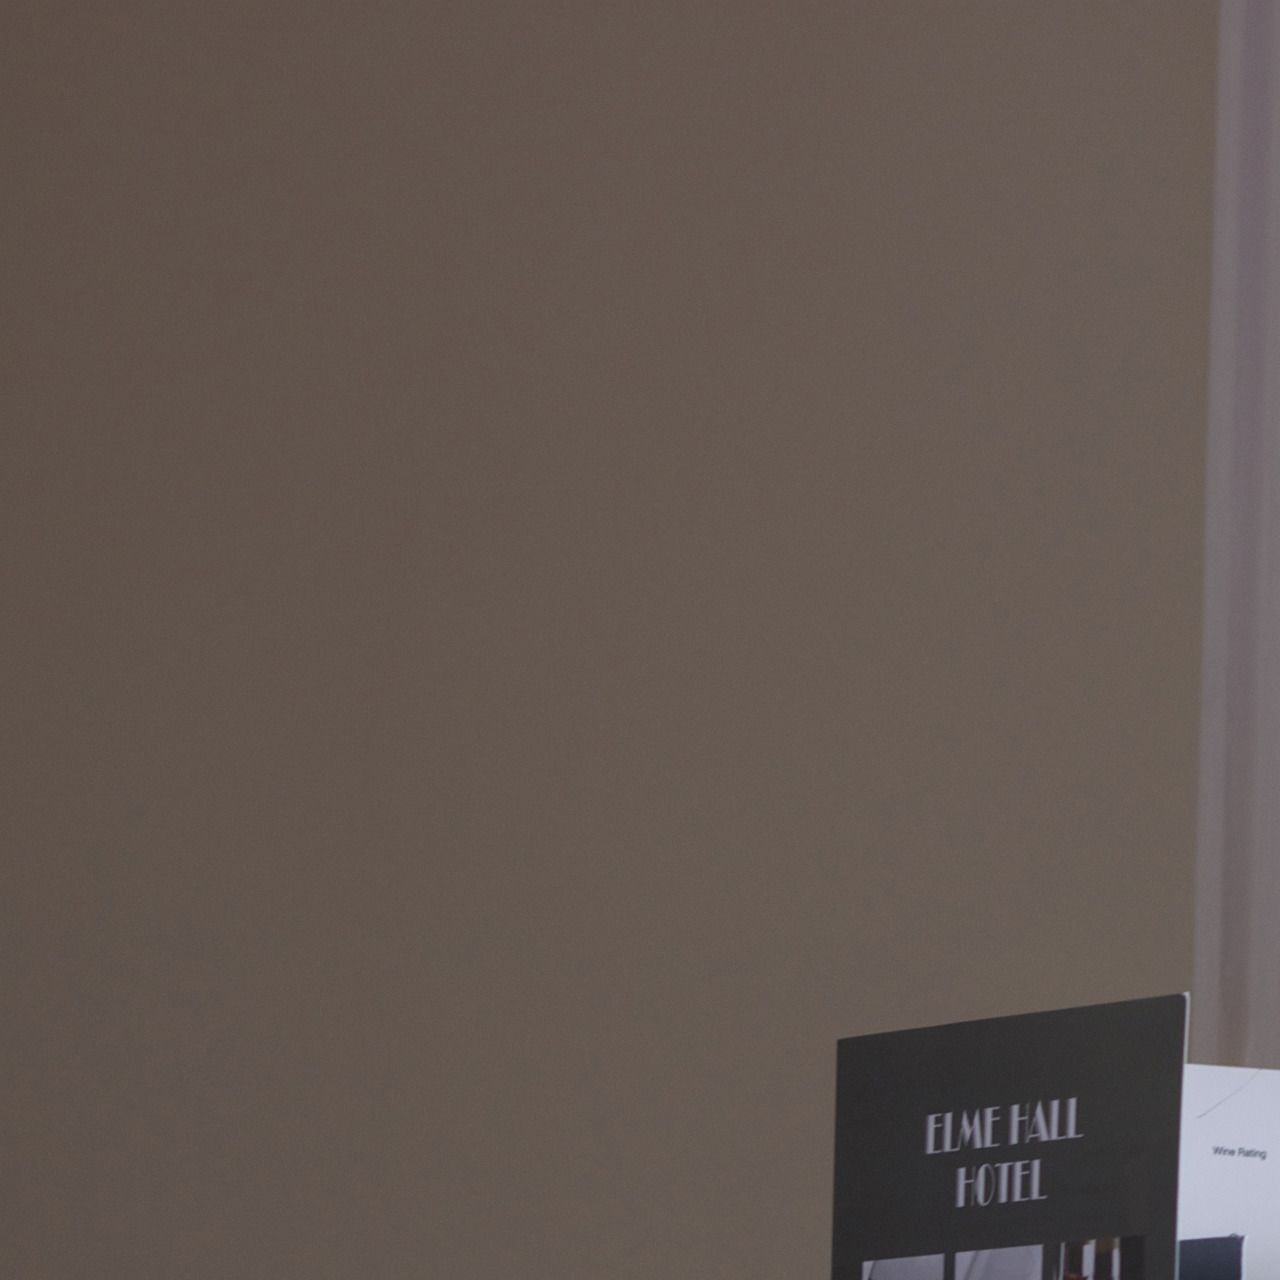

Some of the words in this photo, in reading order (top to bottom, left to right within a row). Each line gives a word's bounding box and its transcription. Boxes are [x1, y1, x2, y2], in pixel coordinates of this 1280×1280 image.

[926, 1106, 1000, 1155] ELME
[1009, 1097, 1085, 1146] HALL
[1212, 1146, 1236, 1157] Wine
[1237, 1147, 1267, 1161] Rating
[956, 1158, 1048, 1208] HOTEL
